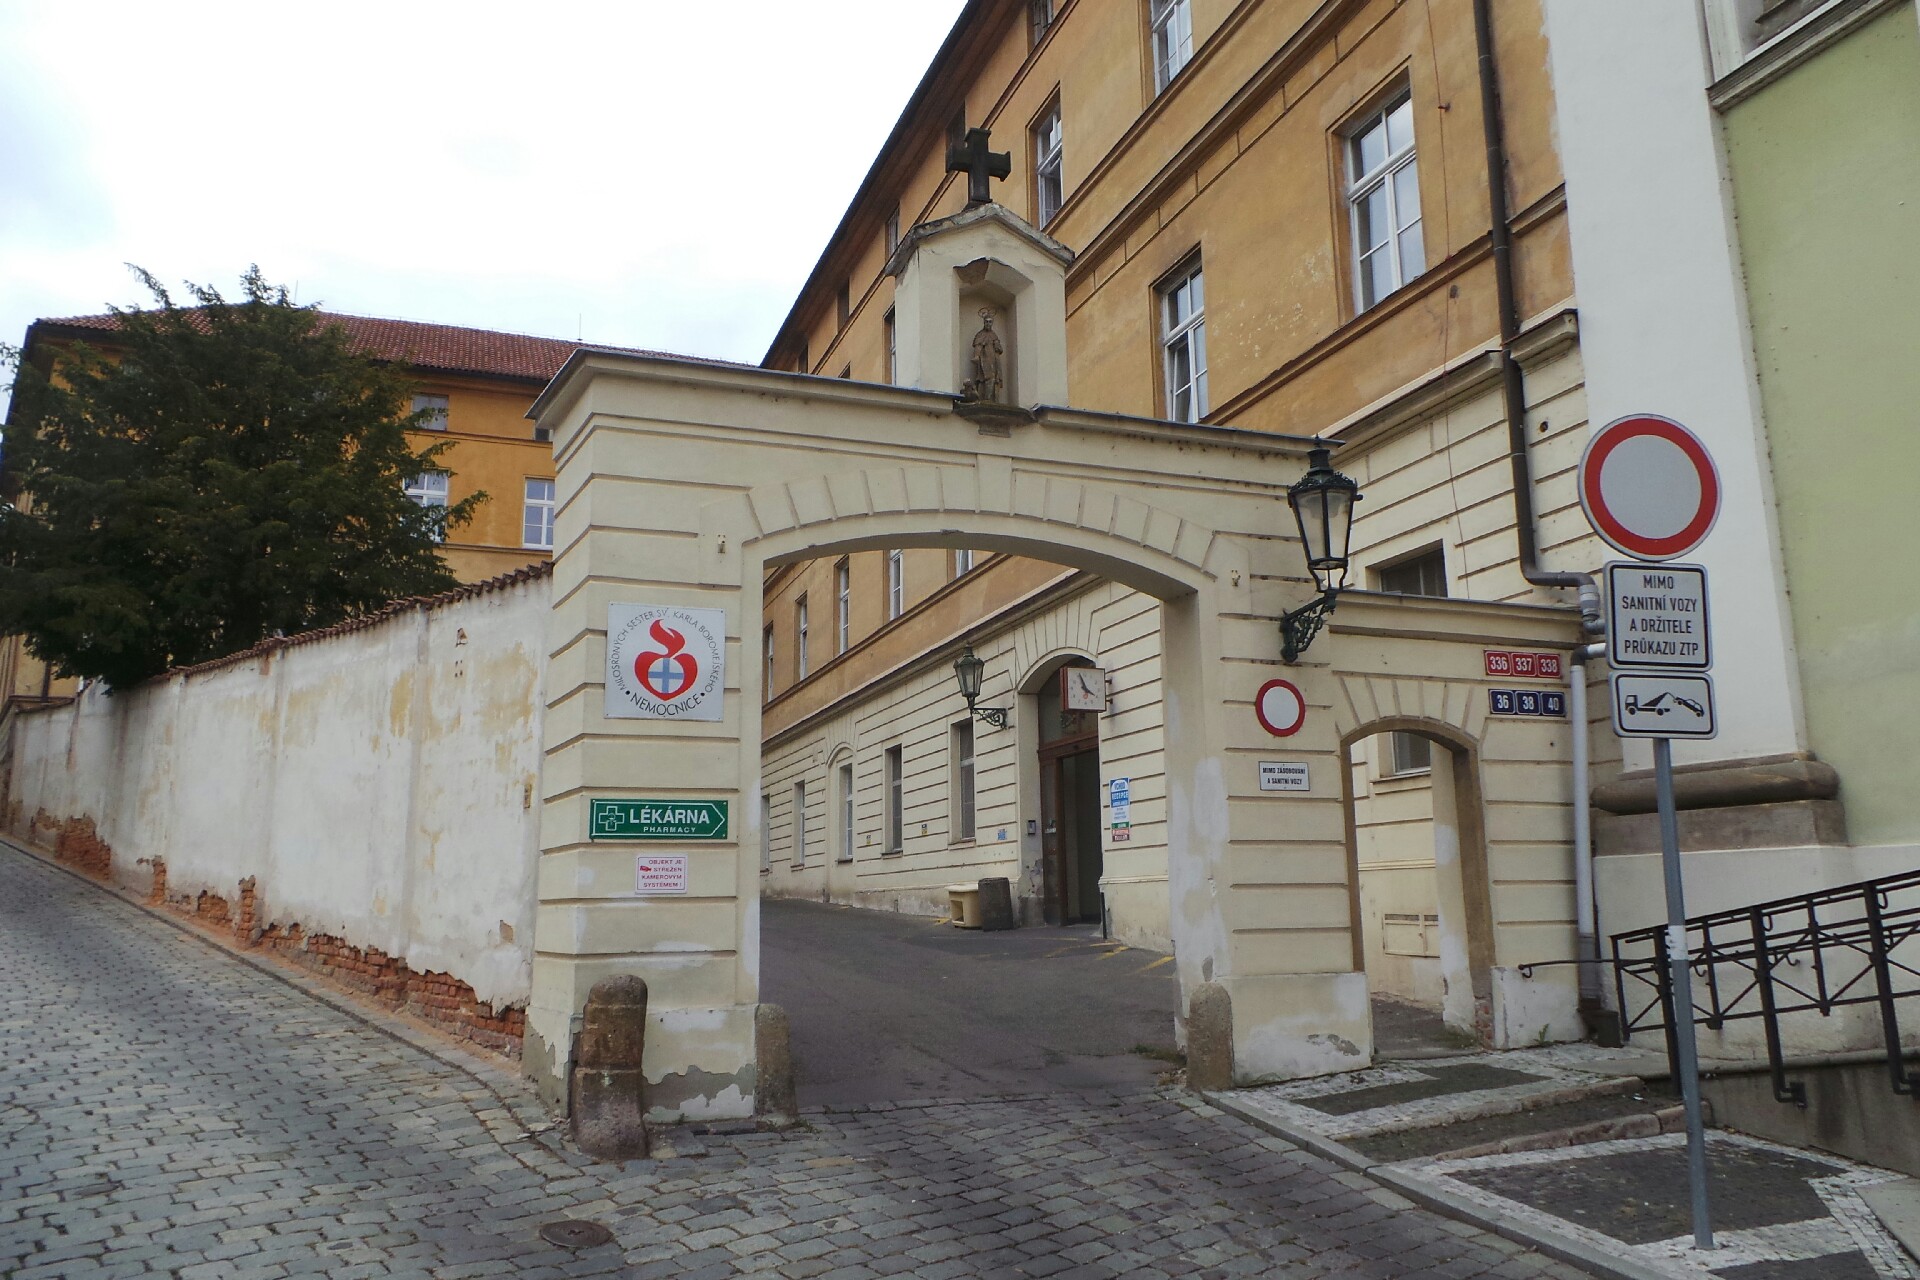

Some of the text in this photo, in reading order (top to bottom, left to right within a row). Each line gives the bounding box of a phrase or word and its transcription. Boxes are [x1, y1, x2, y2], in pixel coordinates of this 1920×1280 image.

[1643, 575, 1674, 589] MIMO
[1622, 595, 1697, 612] SANITNÍ VOZY
[1629, 616, 1692, 633] A DRŽITELE
[611, 629, 629, 690] MILOSRDNÝCH
[627, 611, 653, 630] SESTER
[673, 611, 699, 628] KARLA
[1624, 638, 1699, 656] PRŮKAZU ZTP
[1490, 656, 1558, 672] 336 337 338
[630, 692, 702, 716] NEMOCNICE
[1497, 694, 1559, 711] 36 38 40
[629, 805, 710, 824] LÉKÁRNA
